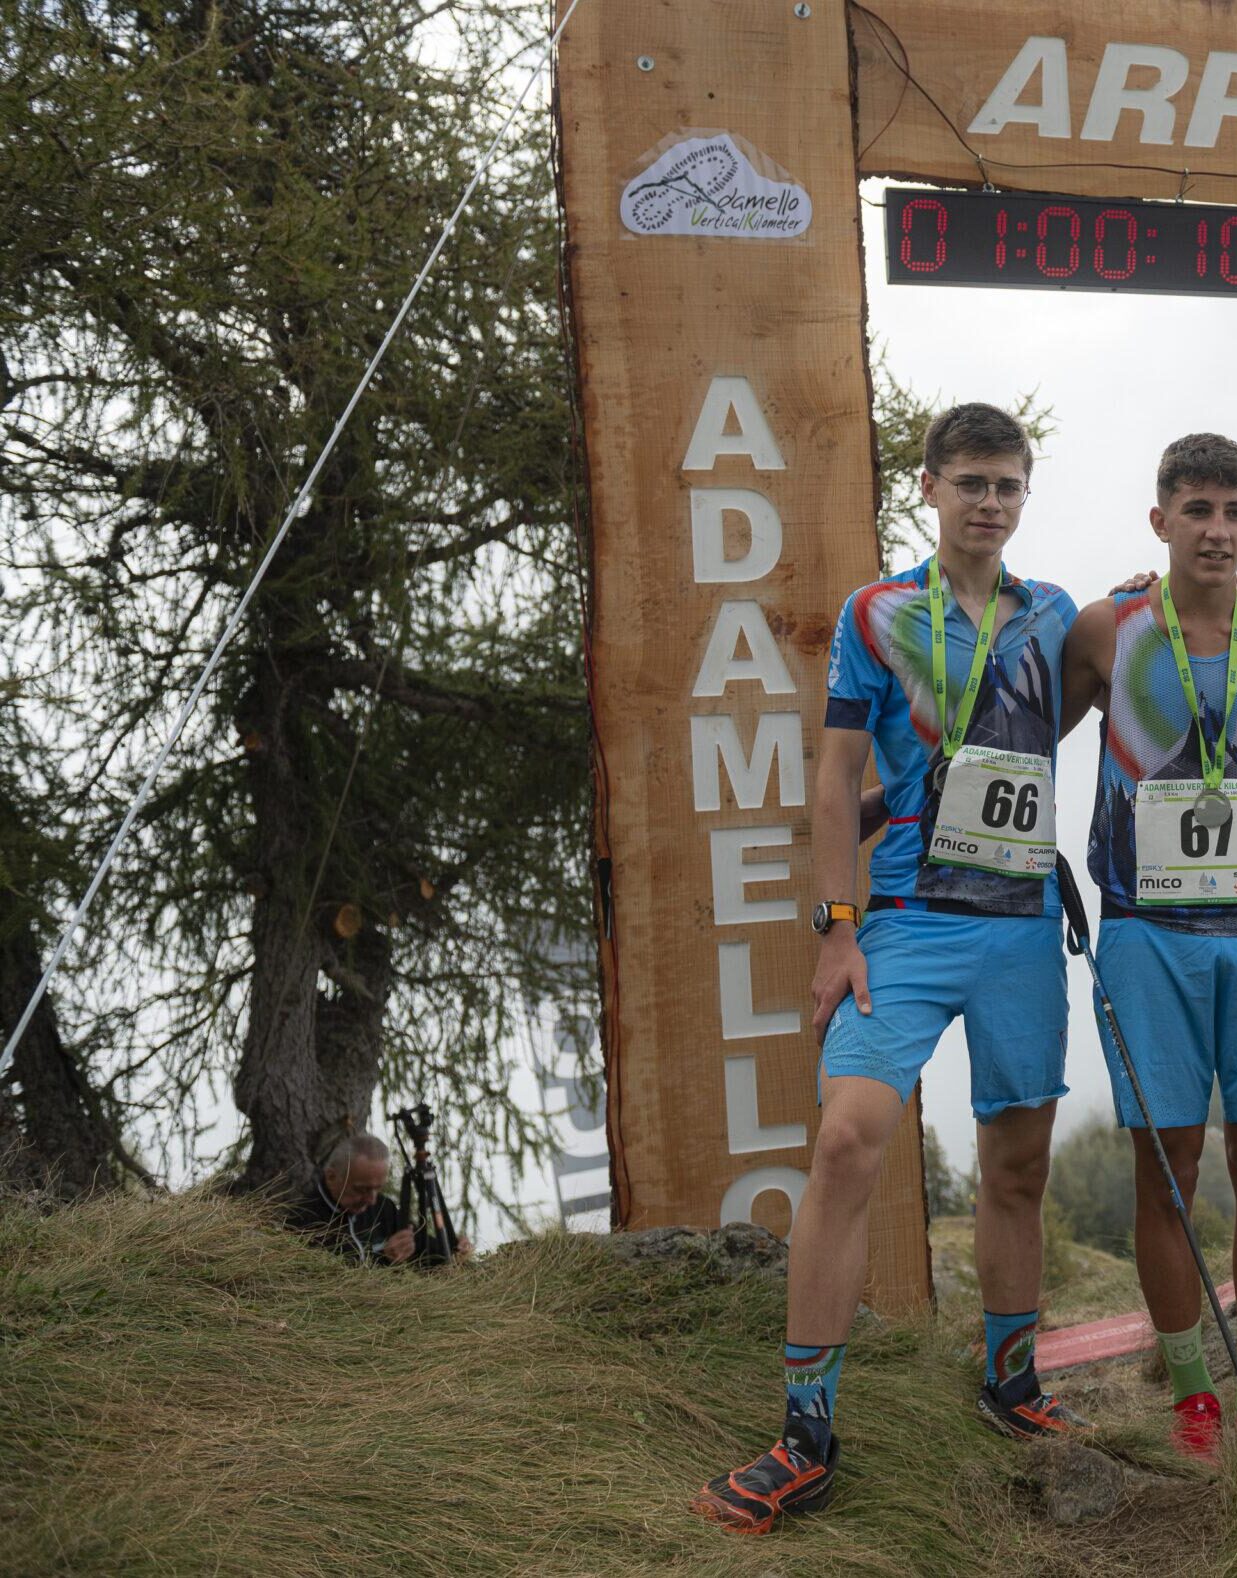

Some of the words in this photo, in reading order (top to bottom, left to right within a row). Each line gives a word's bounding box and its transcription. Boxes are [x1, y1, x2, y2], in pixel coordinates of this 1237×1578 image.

[963, 747, 1005, 761] ADAMELLO
[1144, 783, 1185, 791] ADAMELLO
[682, 375, 809, 1246] ADAMELLO
[981, 779, 1039, 832] 66
[1180, 806, 1234, 859] 67
[934, 837, 979, 855] mico
[1028, 847, 1056, 855] SCARPA
[1140, 878, 1183, 889] mico
